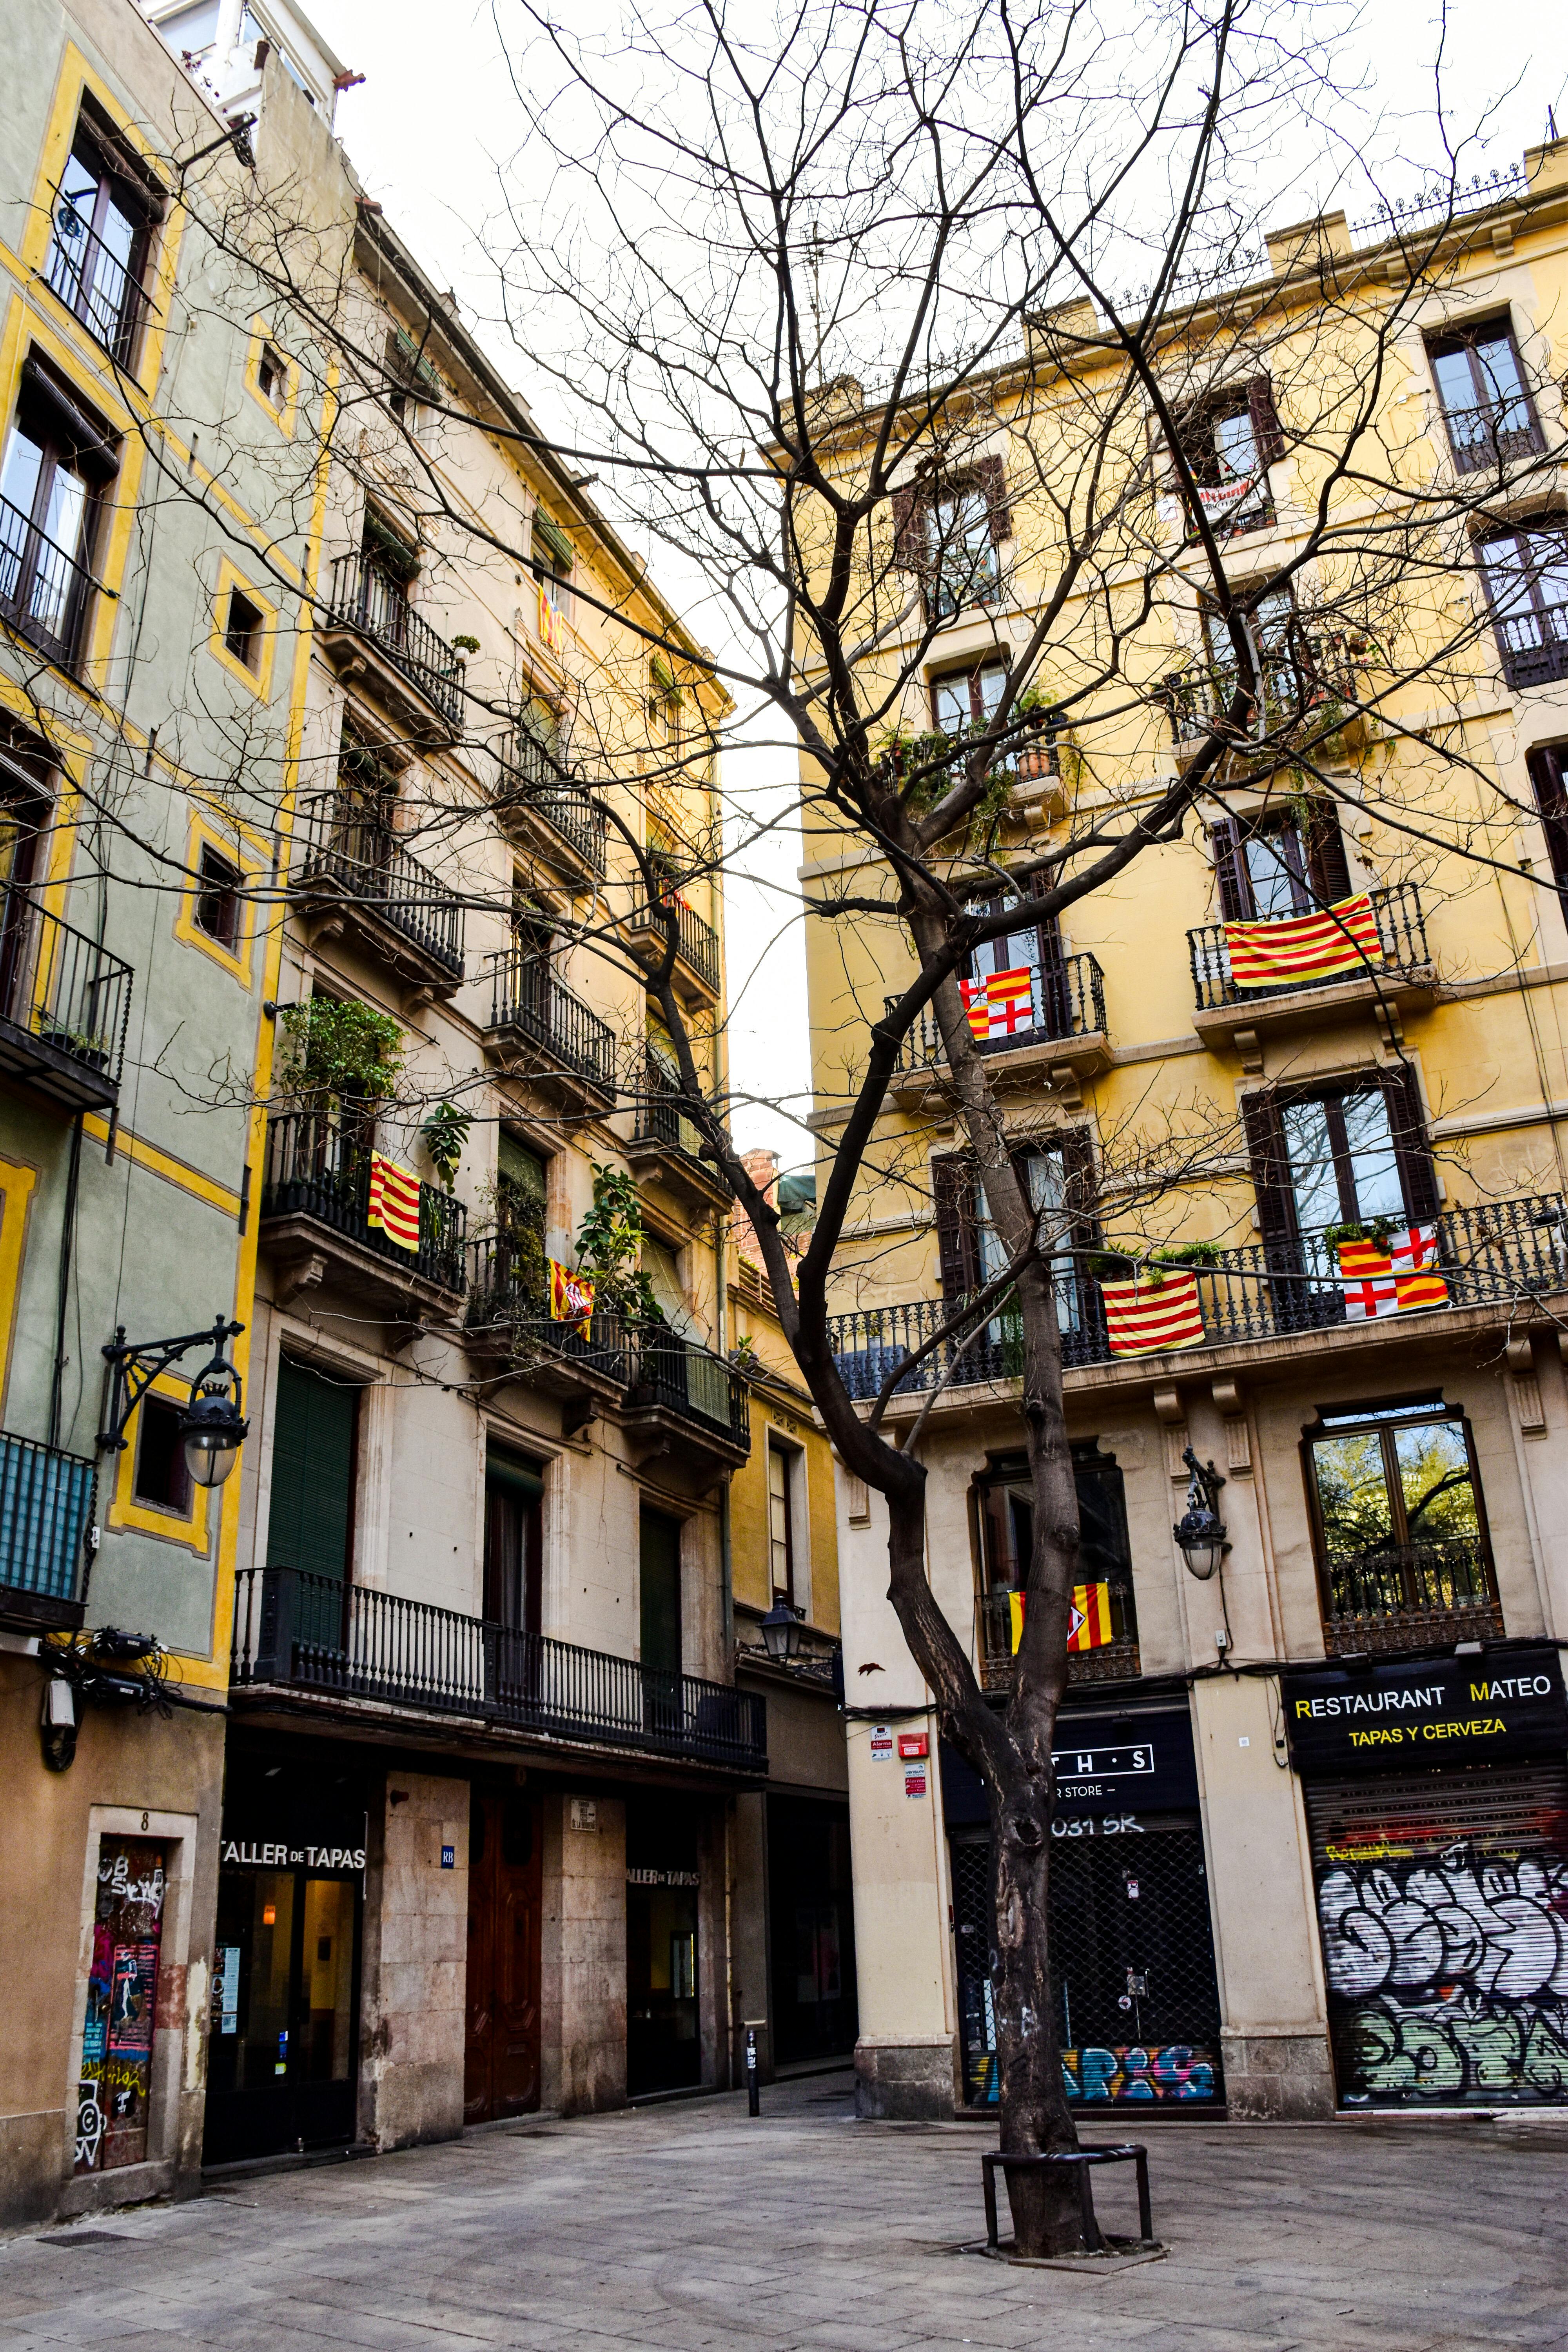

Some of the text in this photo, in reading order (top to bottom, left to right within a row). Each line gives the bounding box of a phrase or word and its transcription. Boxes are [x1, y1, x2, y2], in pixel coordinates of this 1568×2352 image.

[1296, 1675, 1551, 1718] RESTAURANT MATEO
[1348, 1719, 1506, 1746] TAPAS Y CERVEZA
[1065, 1785, 1103, 1797] STORE
[141, 1812, 149, 1831] 8
[290, 1851, 304, 1862] DE
[305, 1846, 366, 1869] TAPAS
[626, 1869, 658, 1884] ALLER
[667, 1871, 700, 1886] TAPAS
